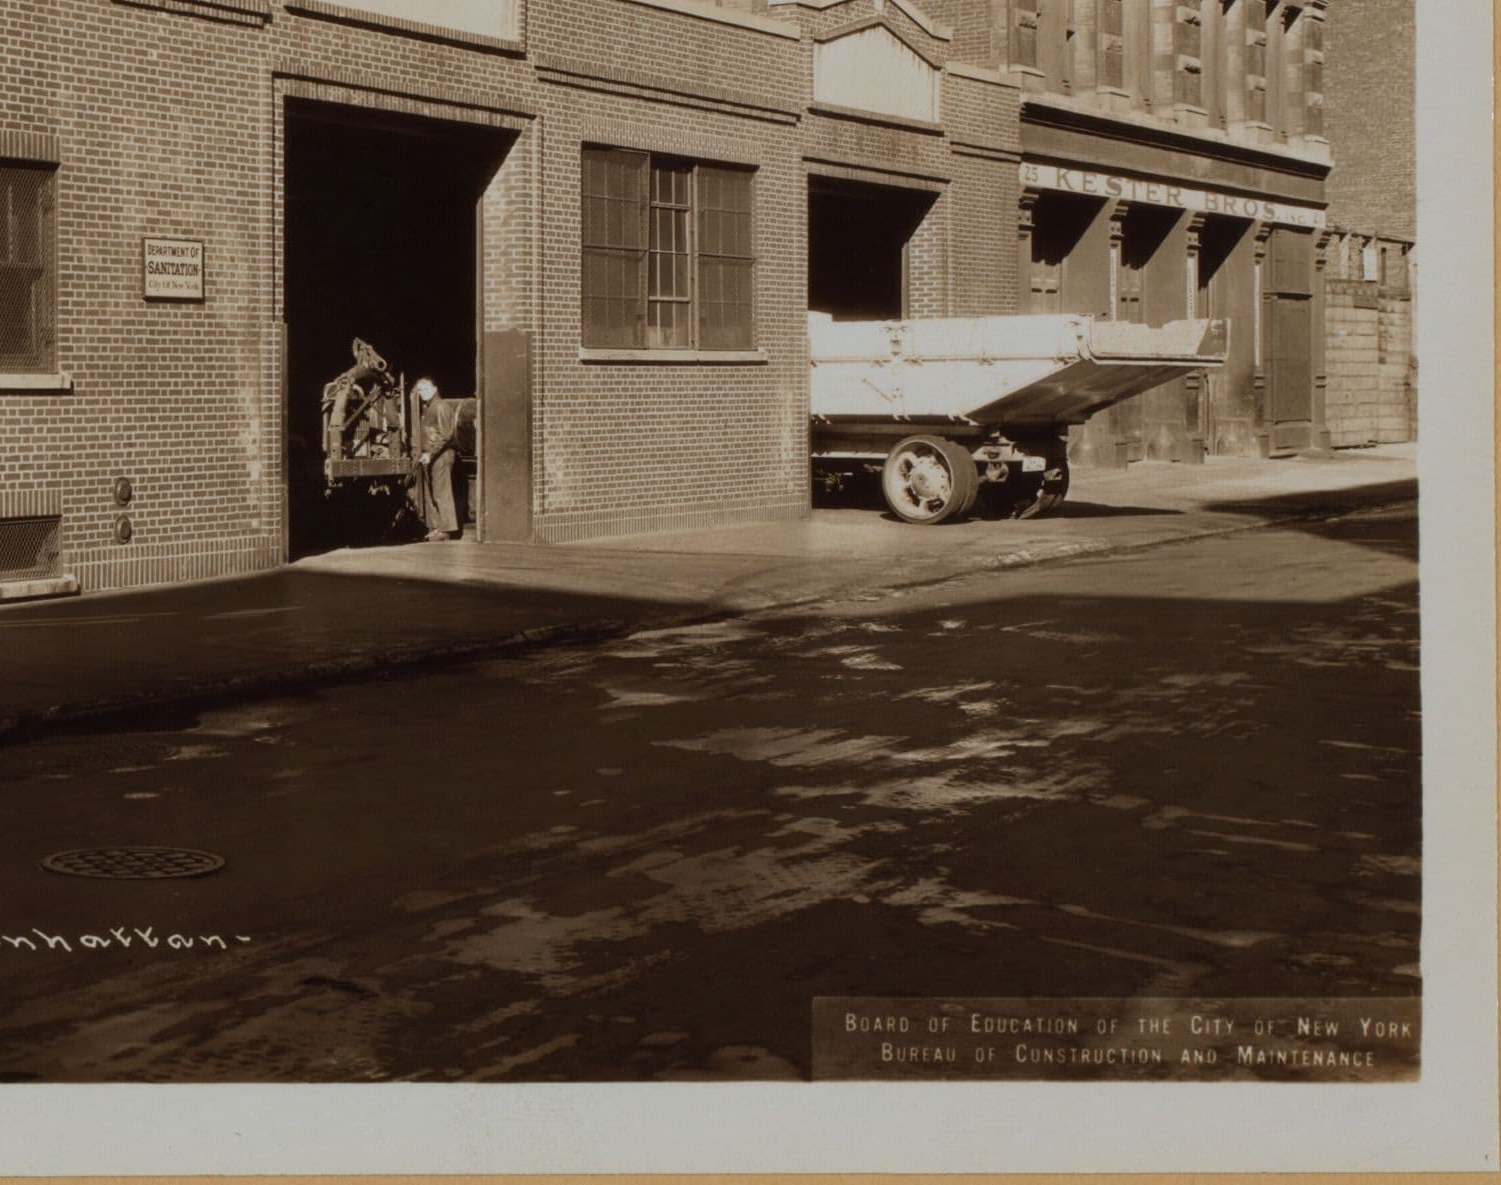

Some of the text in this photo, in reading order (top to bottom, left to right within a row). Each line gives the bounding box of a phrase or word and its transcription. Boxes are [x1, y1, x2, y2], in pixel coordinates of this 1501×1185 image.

[1056, 167, 1184, 206] KESTER
[148, 244, 199, 258] DEPARTMENT OF
[147, 260, 198, 276] SANITATION
